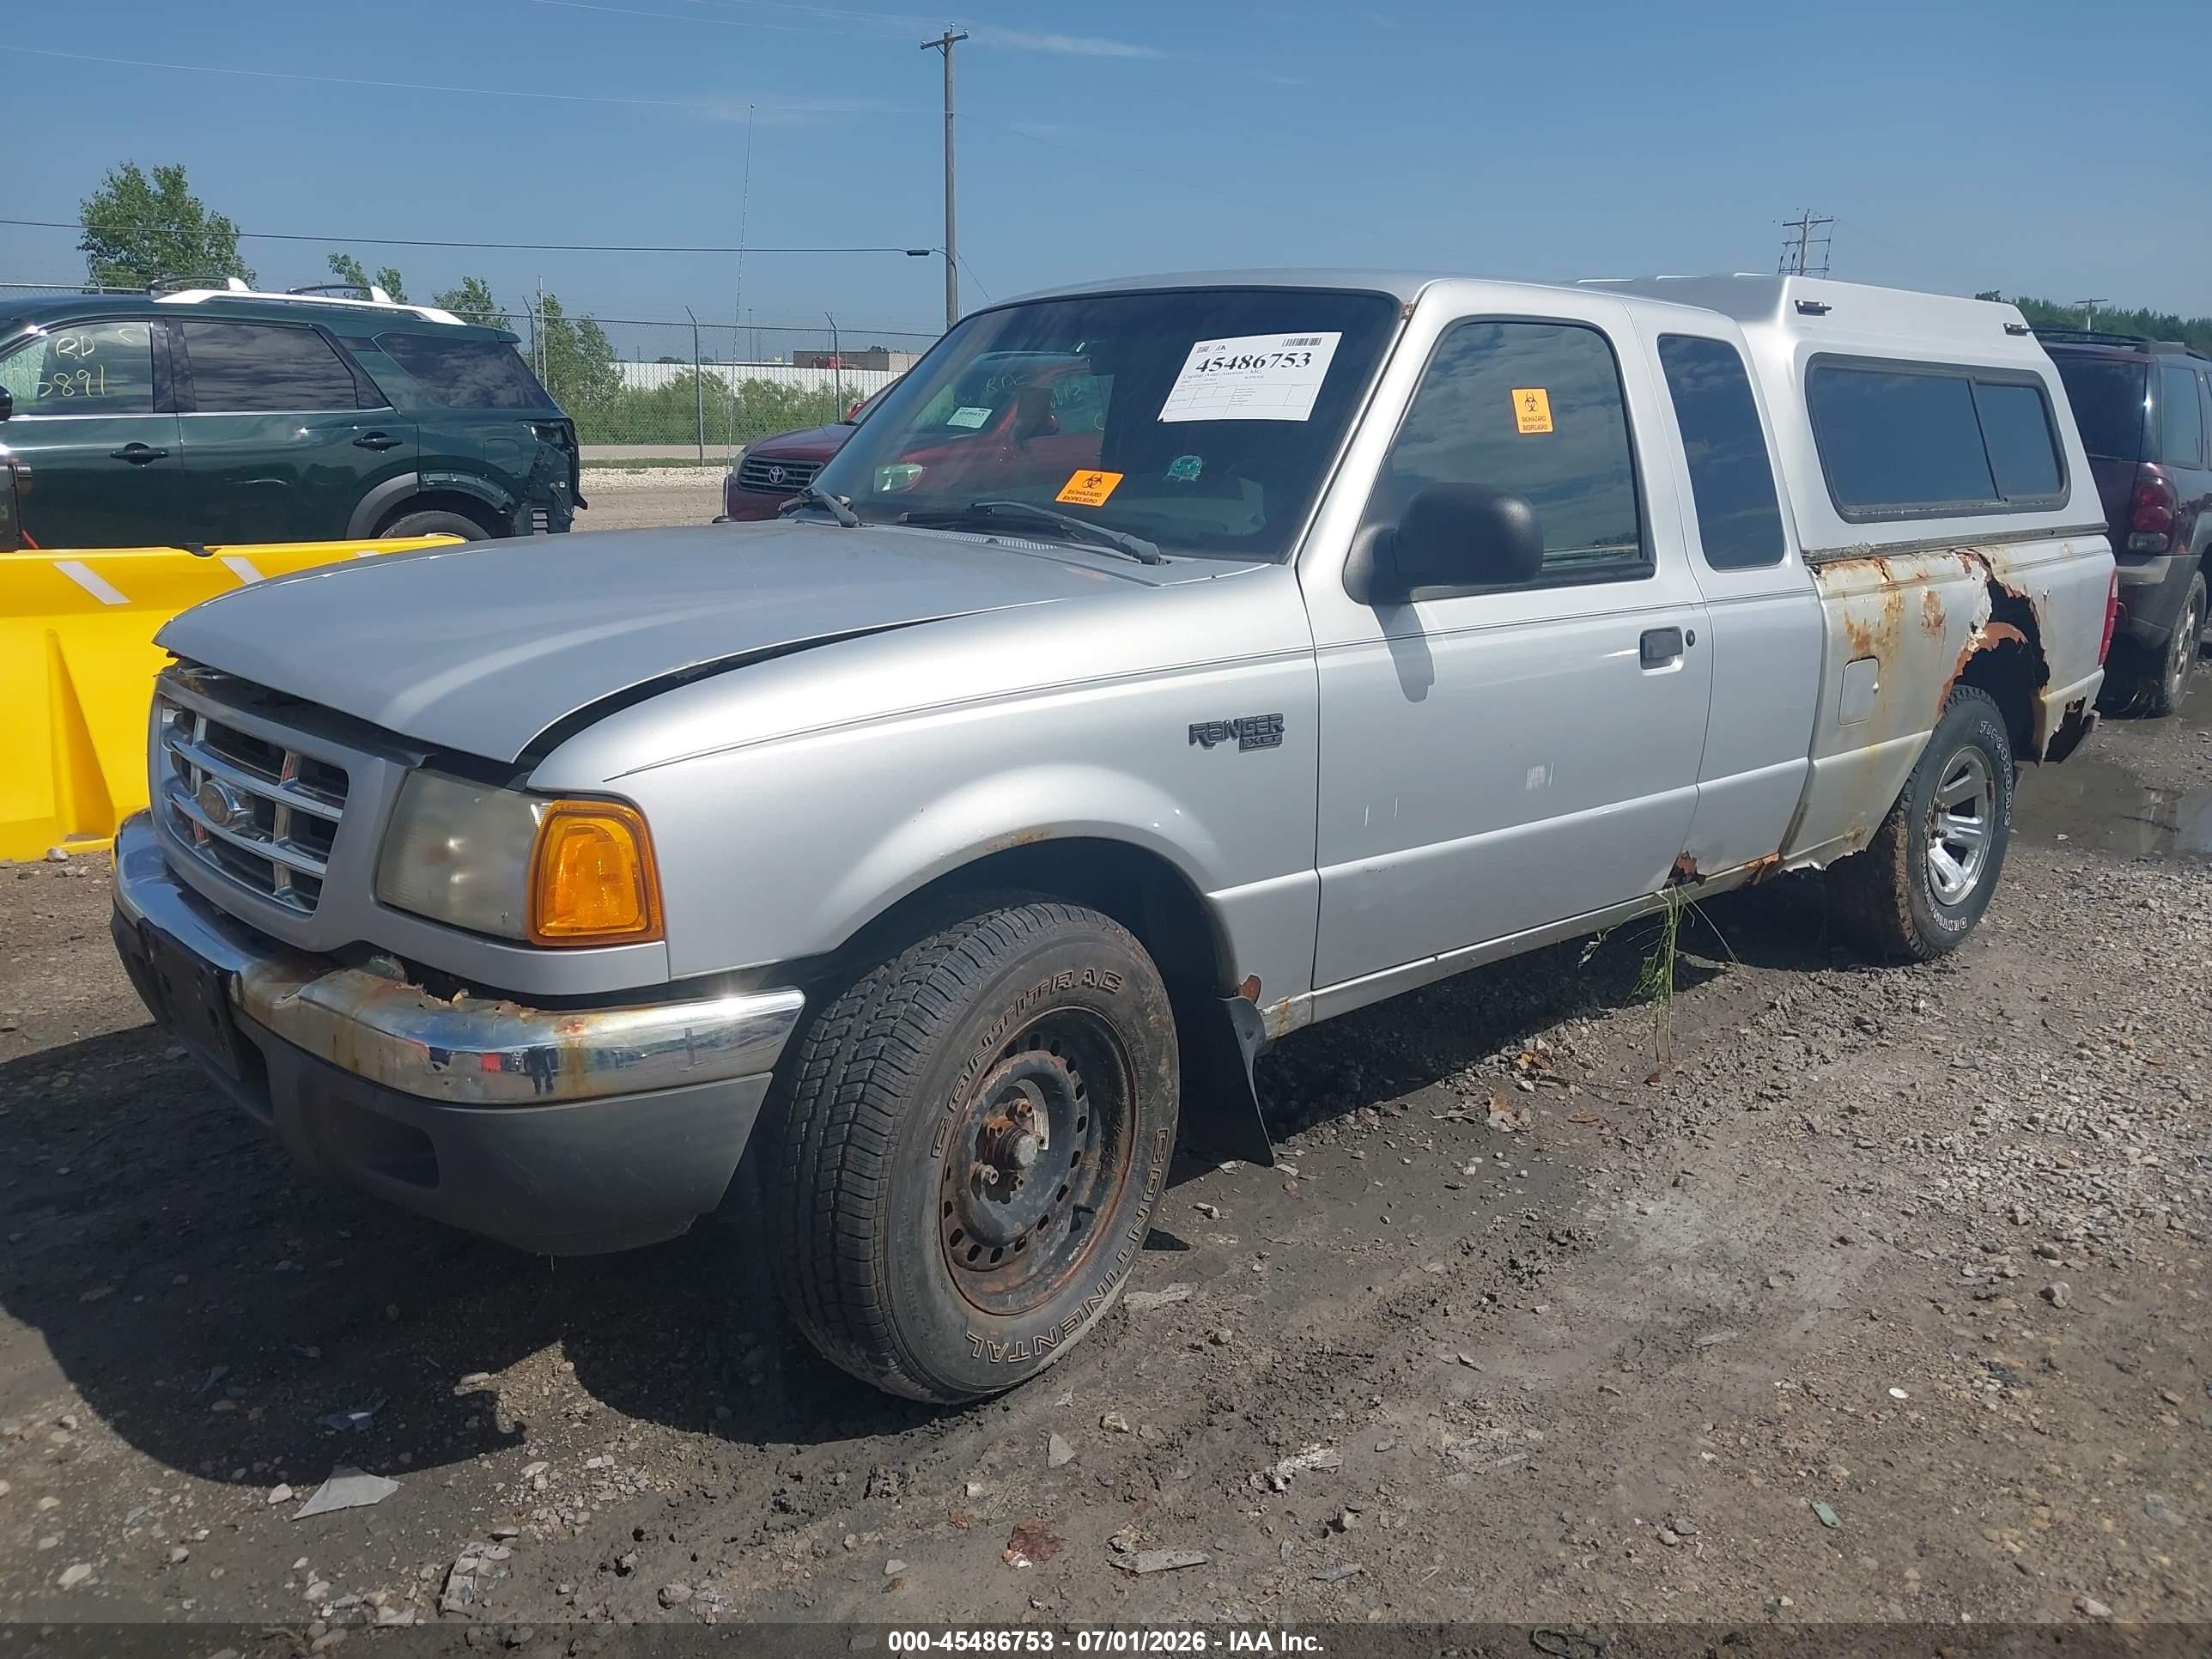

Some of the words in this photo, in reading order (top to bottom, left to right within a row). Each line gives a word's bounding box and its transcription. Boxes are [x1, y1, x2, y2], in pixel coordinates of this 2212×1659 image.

[56, 336, 95, 361] RD
[1195, 352, 1312, 373] 45486753
[1062, 495, 1098, 504] BIOPELIGRO
[1067, 489, 1103, 498] BIOHAZARD
[931, 968, 1124, 1158] CONTITRAC
[965, 1127, 1170, 1364] CONTINENTAL
